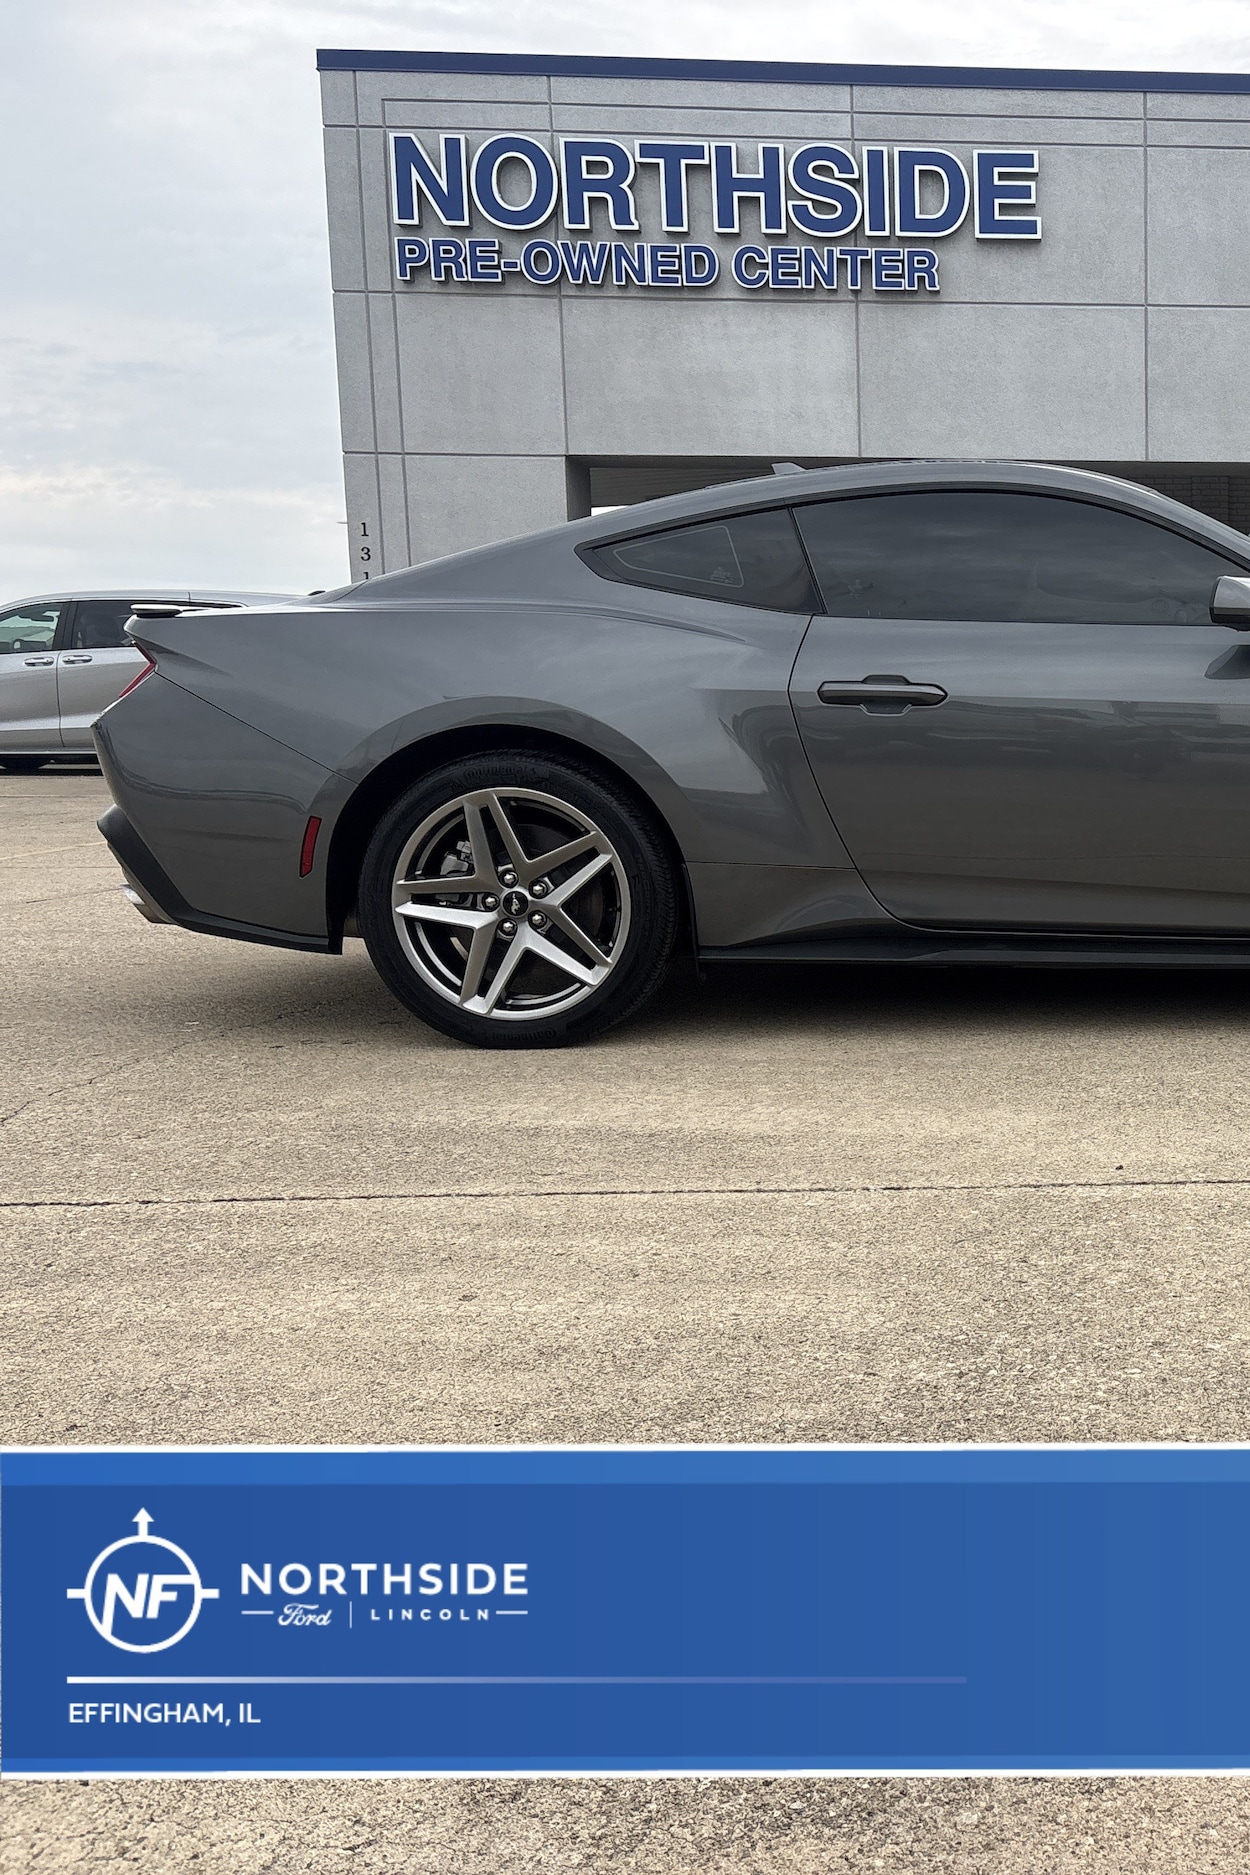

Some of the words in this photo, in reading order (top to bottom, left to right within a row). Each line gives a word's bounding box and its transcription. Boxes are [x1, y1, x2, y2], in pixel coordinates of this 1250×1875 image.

[389, 132, 1042, 240] NORTHSIDE
[397, 237, 719, 287] PRE-OWNED
[732, 245, 940, 291] CENTER
